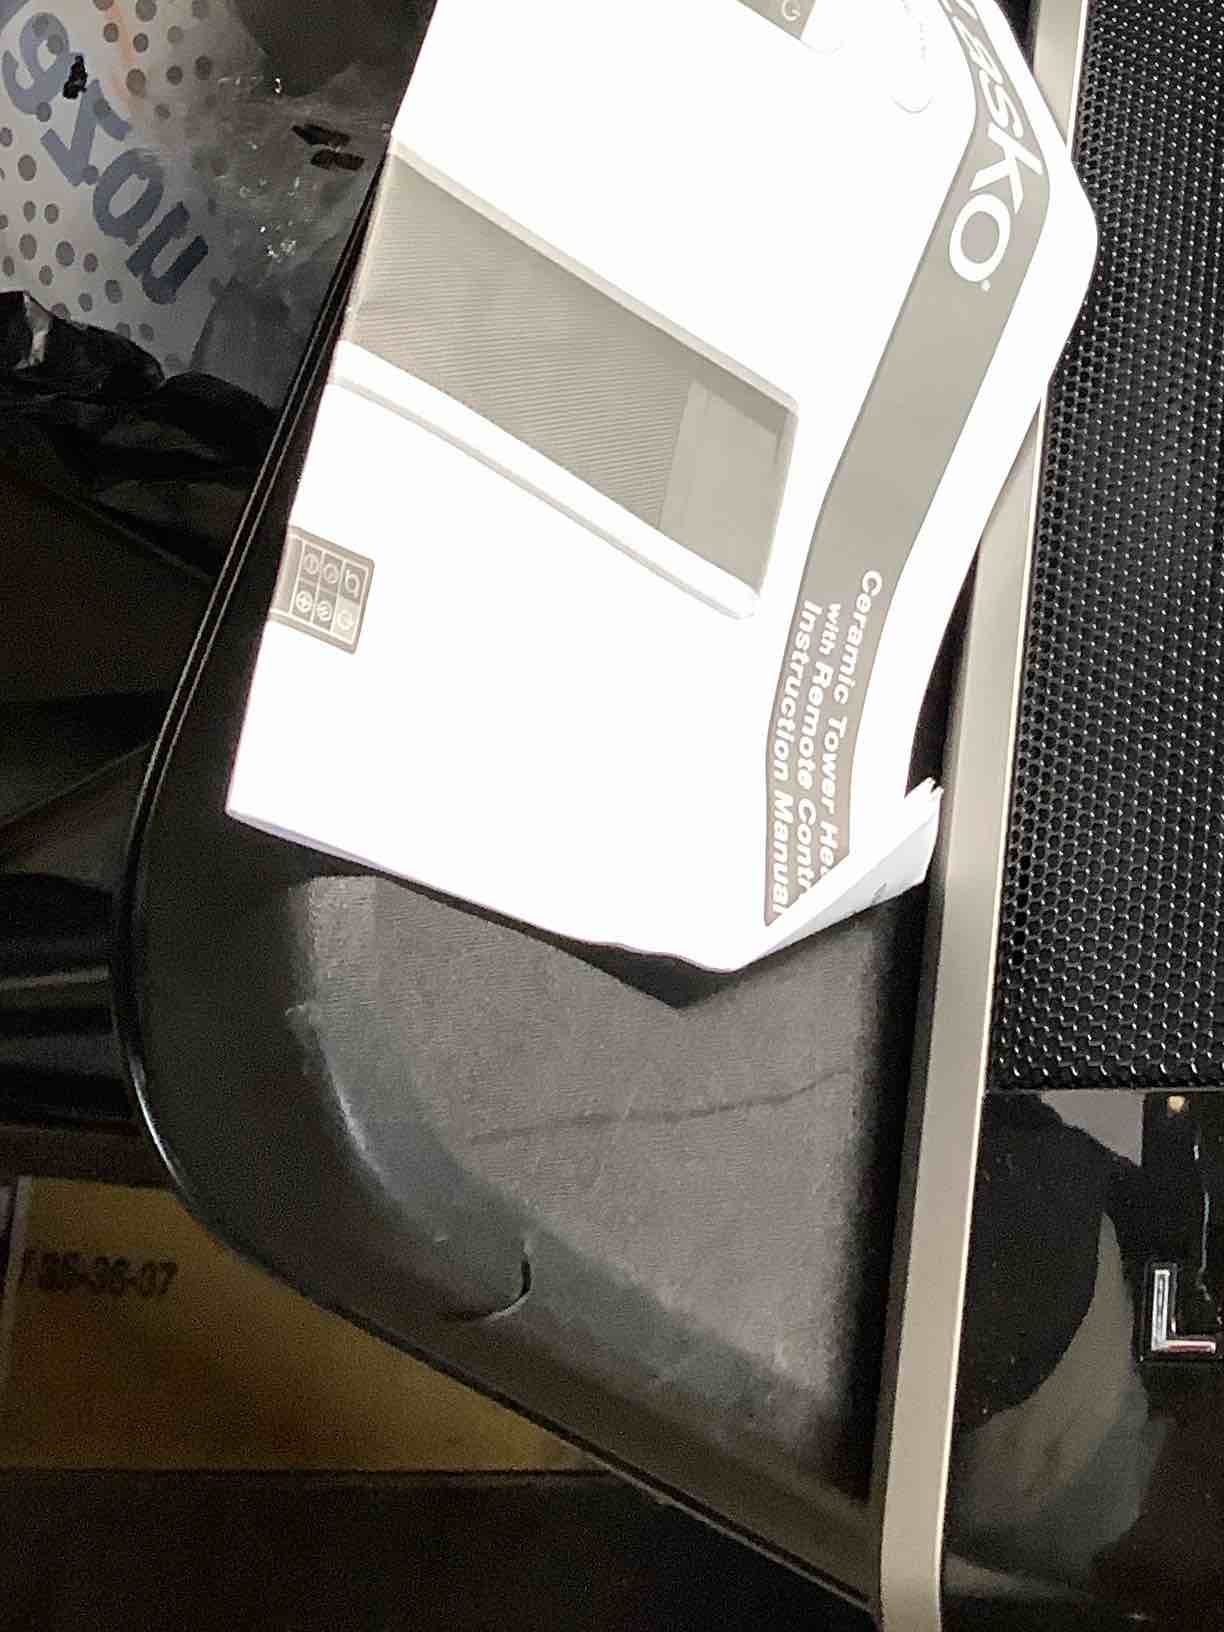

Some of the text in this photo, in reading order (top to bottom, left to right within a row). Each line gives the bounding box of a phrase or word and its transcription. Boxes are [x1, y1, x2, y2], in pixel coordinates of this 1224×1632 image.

[818, 602, 842, 656] with
[831, 569, 884, 706] Ceramic
[771, 599, 823, 914] Instruction Manual
[797, 658, 834, 788] Remote
[821, 714, 849, 817] Tower
